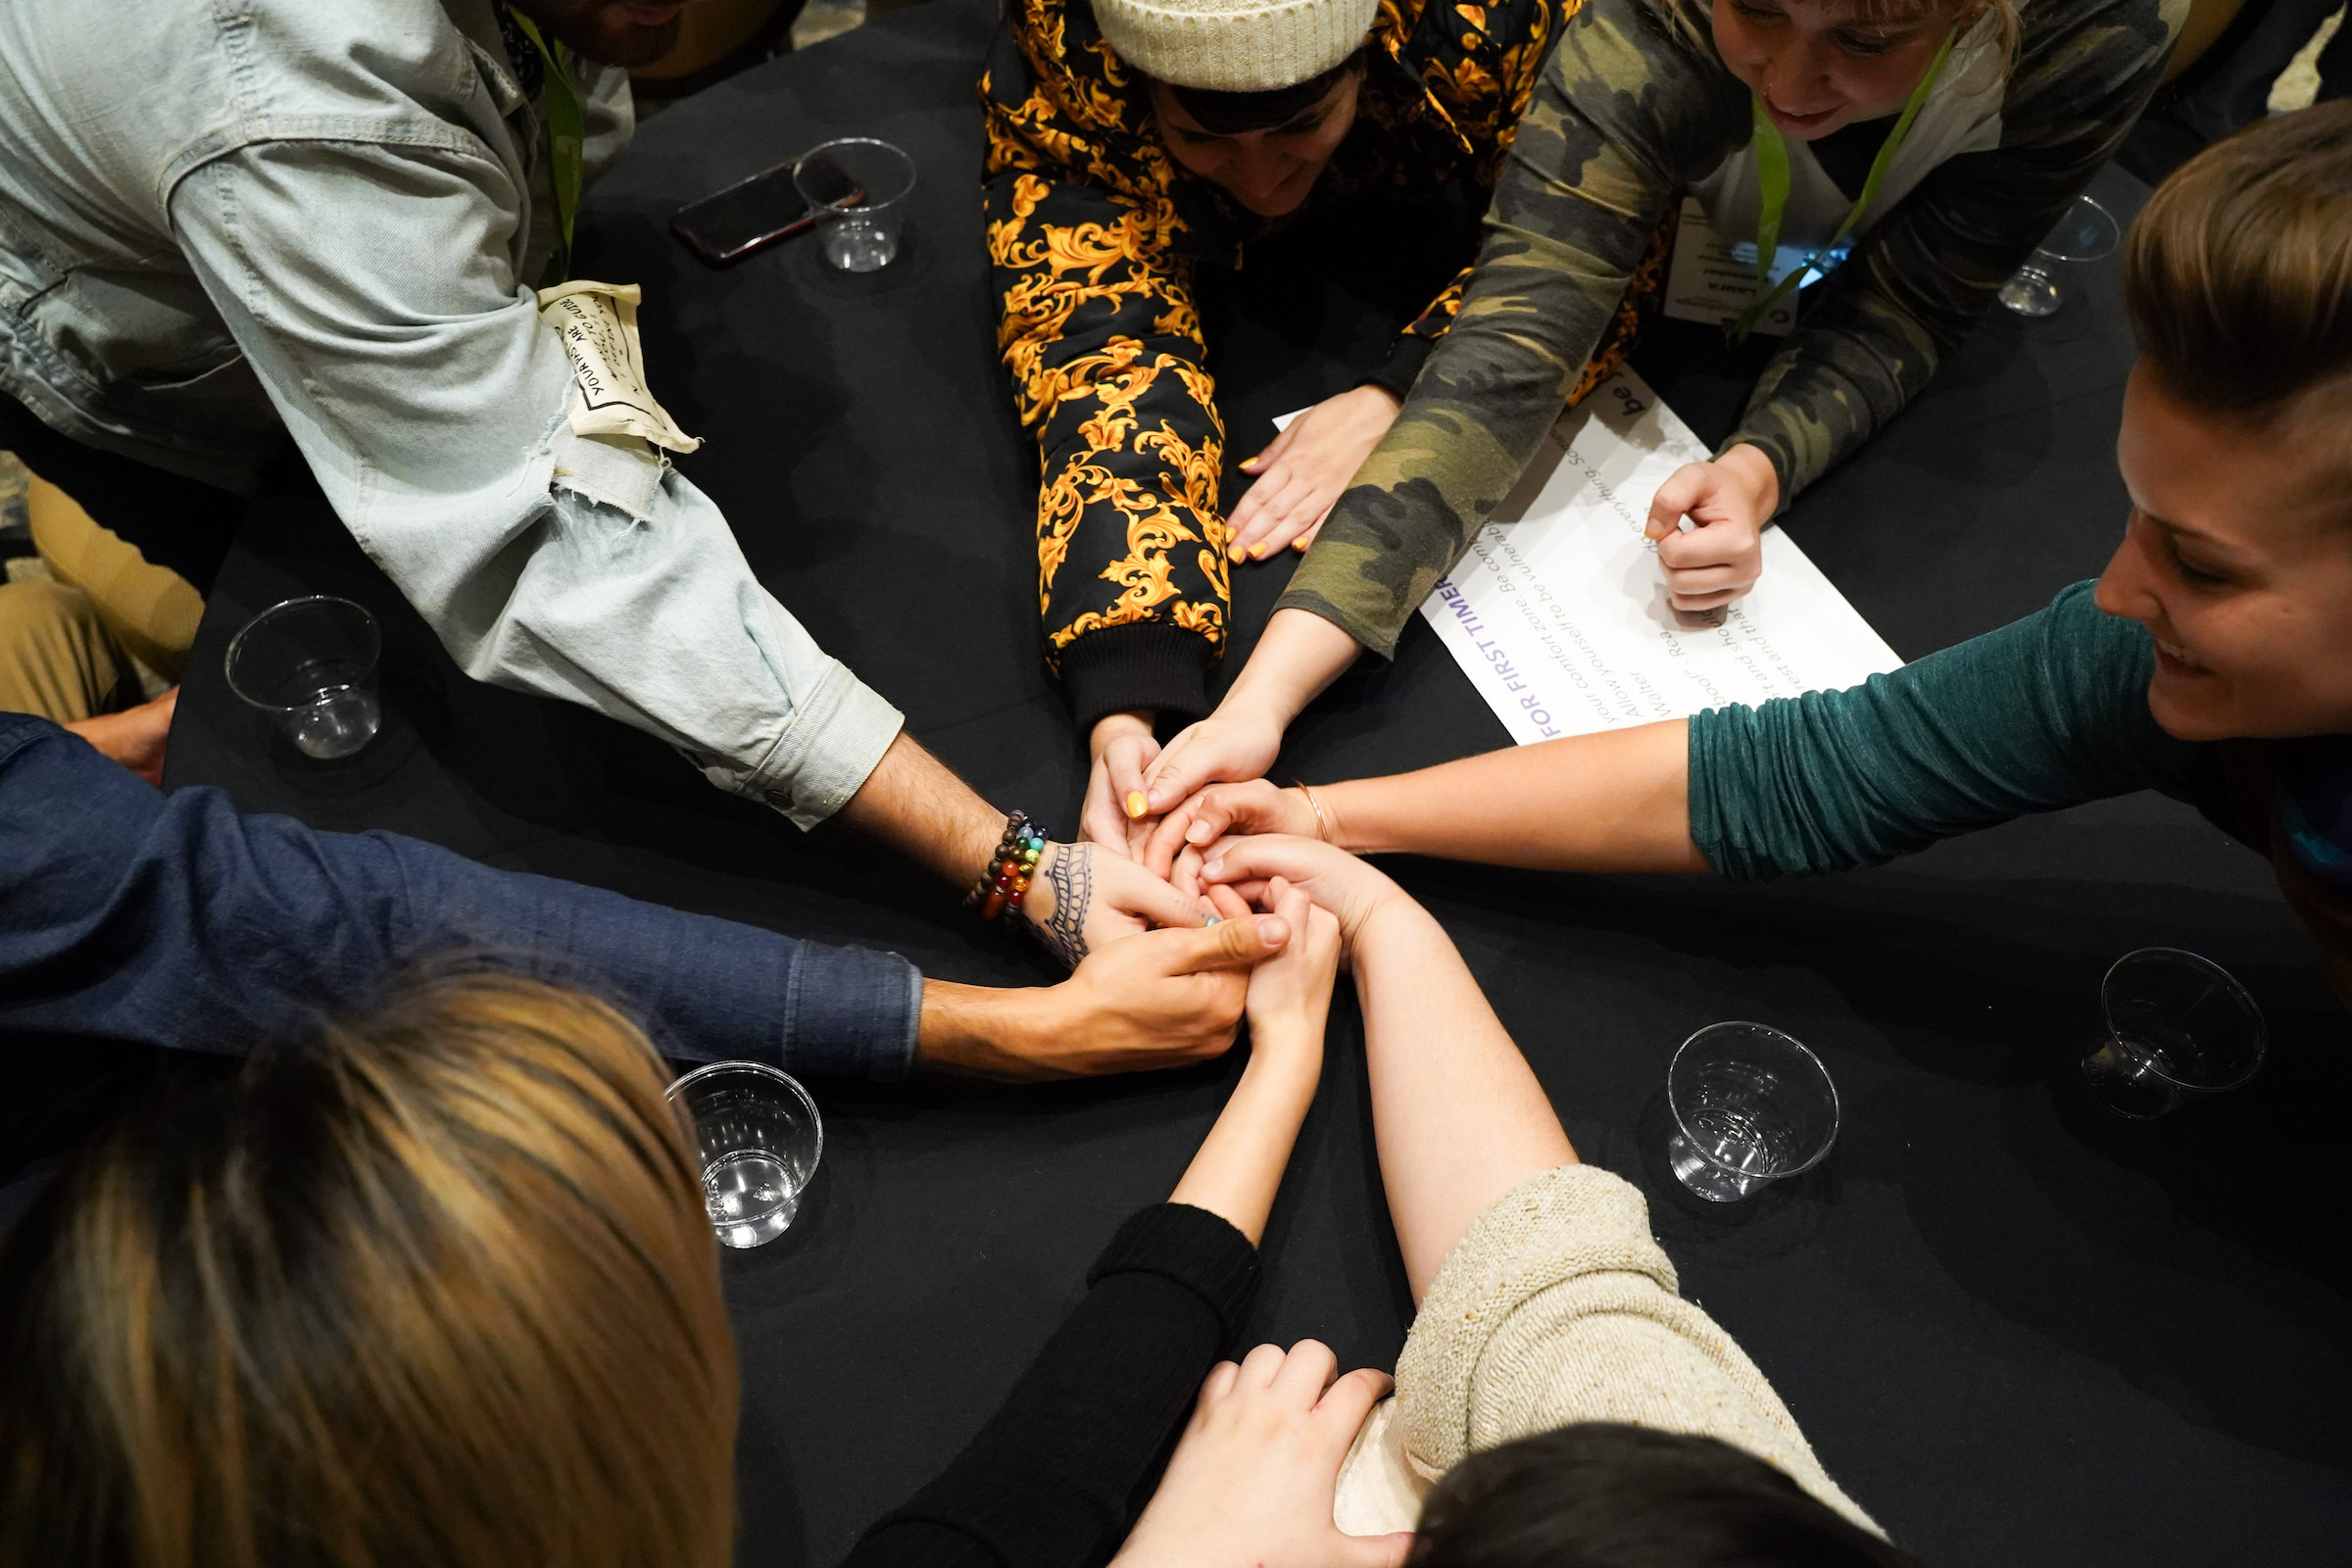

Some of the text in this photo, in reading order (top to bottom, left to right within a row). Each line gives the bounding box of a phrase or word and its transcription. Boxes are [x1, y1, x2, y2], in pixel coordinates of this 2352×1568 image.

[560, 299, 587, 318] GUIDE
[568, 326, 586, 341] ARE
[582, 322, 596, 334] TO
[579, 363, 604, 396] YOUR
[1613, 387, 1646, 416] be
[1585, 466, 1642, 533] everything.
[1497, 575, 1516, 593] Be
[1534, 584, 1552, 602] be
[1515, 596, 1546, 631] zone.
[1550, 605, 1566, 618] to
[1726, 609, 1756, 633] that
[1541, 635, 1589, 689] comfort
[1556, 622, 1615, 676] yourself
[1748, 637, 1781, 662] and
[1476, 641, 1527, 692] FIRST
[1734, 656, 1767, 680] and
[1584, 694, 1621, 724] your
[1605, 680, 1643, 716] Allow
[1630, 672, 1672, 717] Walter
[1520, 695, 1561, 738] FOR
